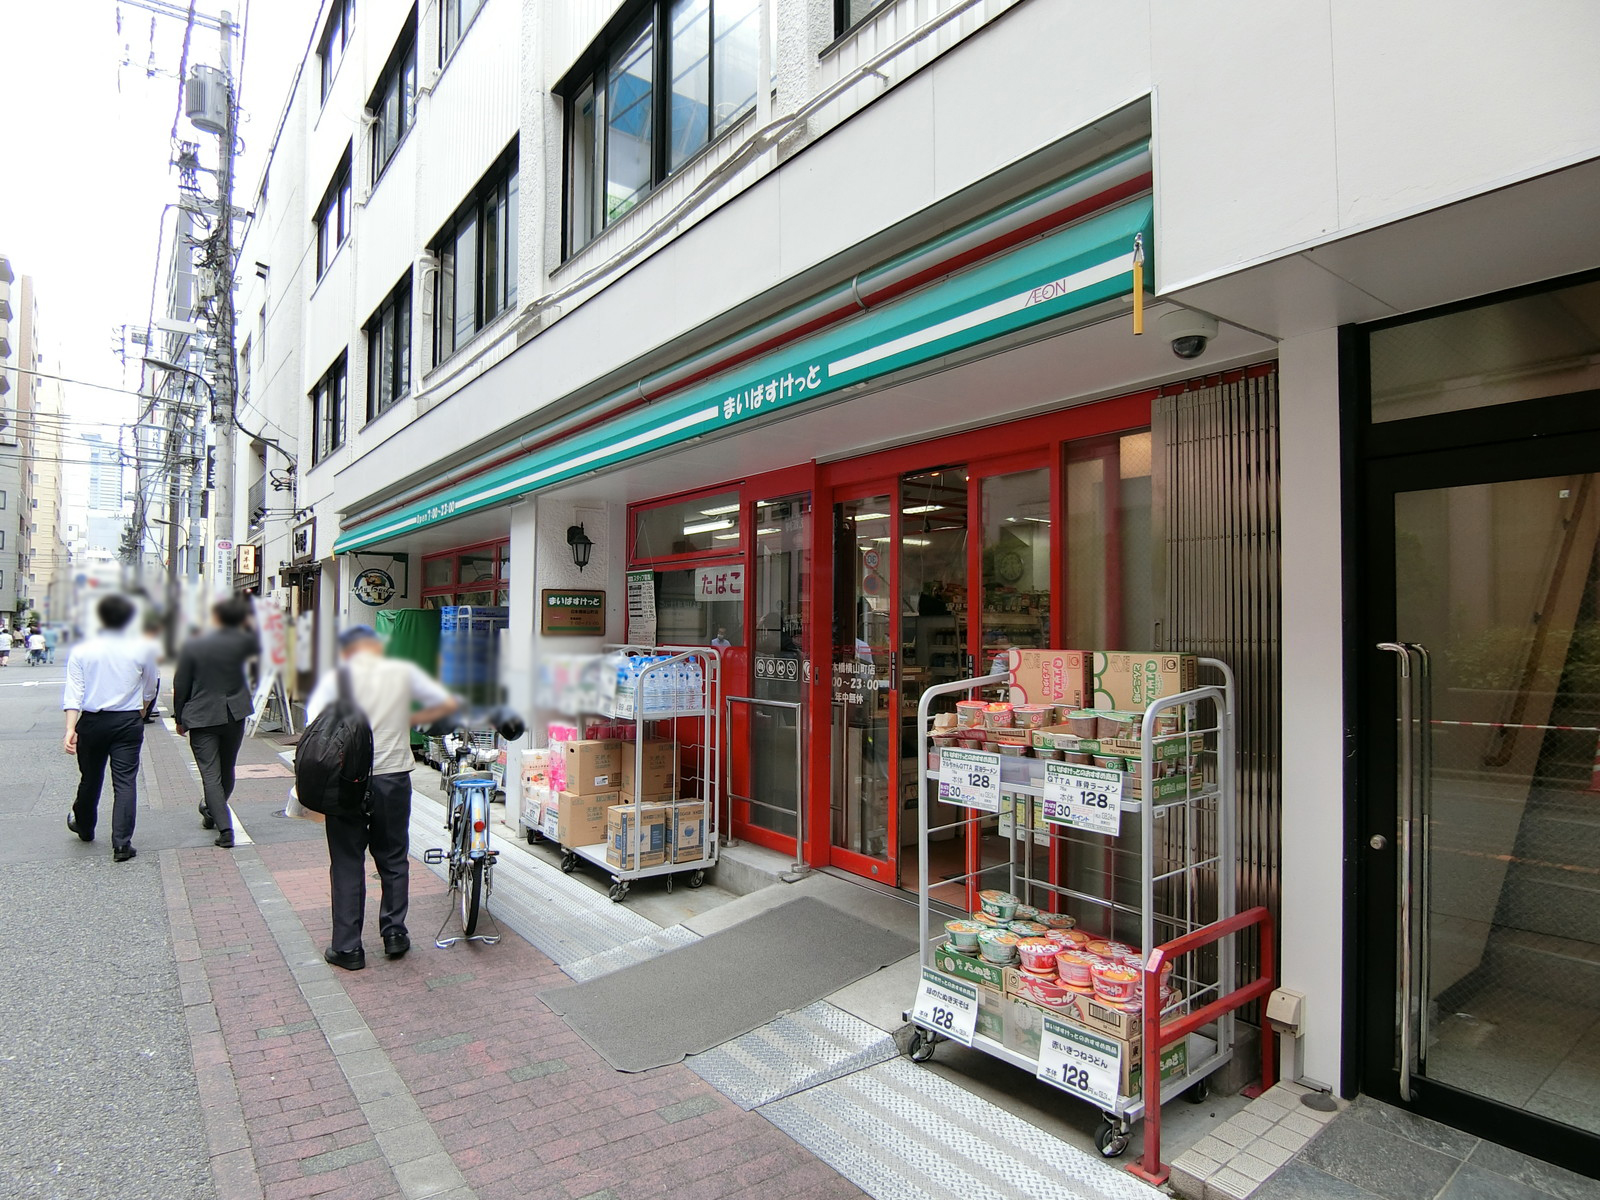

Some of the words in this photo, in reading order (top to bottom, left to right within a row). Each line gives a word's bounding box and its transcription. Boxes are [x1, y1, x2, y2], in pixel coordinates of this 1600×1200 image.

[724, 365, 821, 419] まいばすけっと
[702, 572, 740, 594] たばこ
[548, 597, 600, 606] まいばすけっと
[1042, 662, 1050, 696] しょうゆ味
[1053, 657, 1064, 701] QTTA
[1132, 664, 1142, 704] とんこつ味
[834, 692, 864, 704] 年中無休
[968, 773, 990, 788] 128
[1048, 765, 1118, 780] まいばすけっとのおすすめ商品
[950, 786, 961, 797] 30
[1047, 776, 1070, 786] QTTA
[1076, 780, 1118, 793] 豚骨ラーメン
[1060, 794, 1074, 803] 本体
[1080, 791, 1108, 808] 128
[1057, 804, 1070, 817] 30
[1072, 814, 1089, 822] ポイント
[926, 987, 969, 1010] 緑のたぬき天そば
[932, 1006, 954, 1029] 128
[1045, 1022, 1117, 1053] まいばすけっとのおすすめ商品
[1052, 1040, 1108, 1069] 赤いきつねうどん
[1045, 1067, 1057, 1077] 本体
[1062, 1063, 1089, 1091] 128
